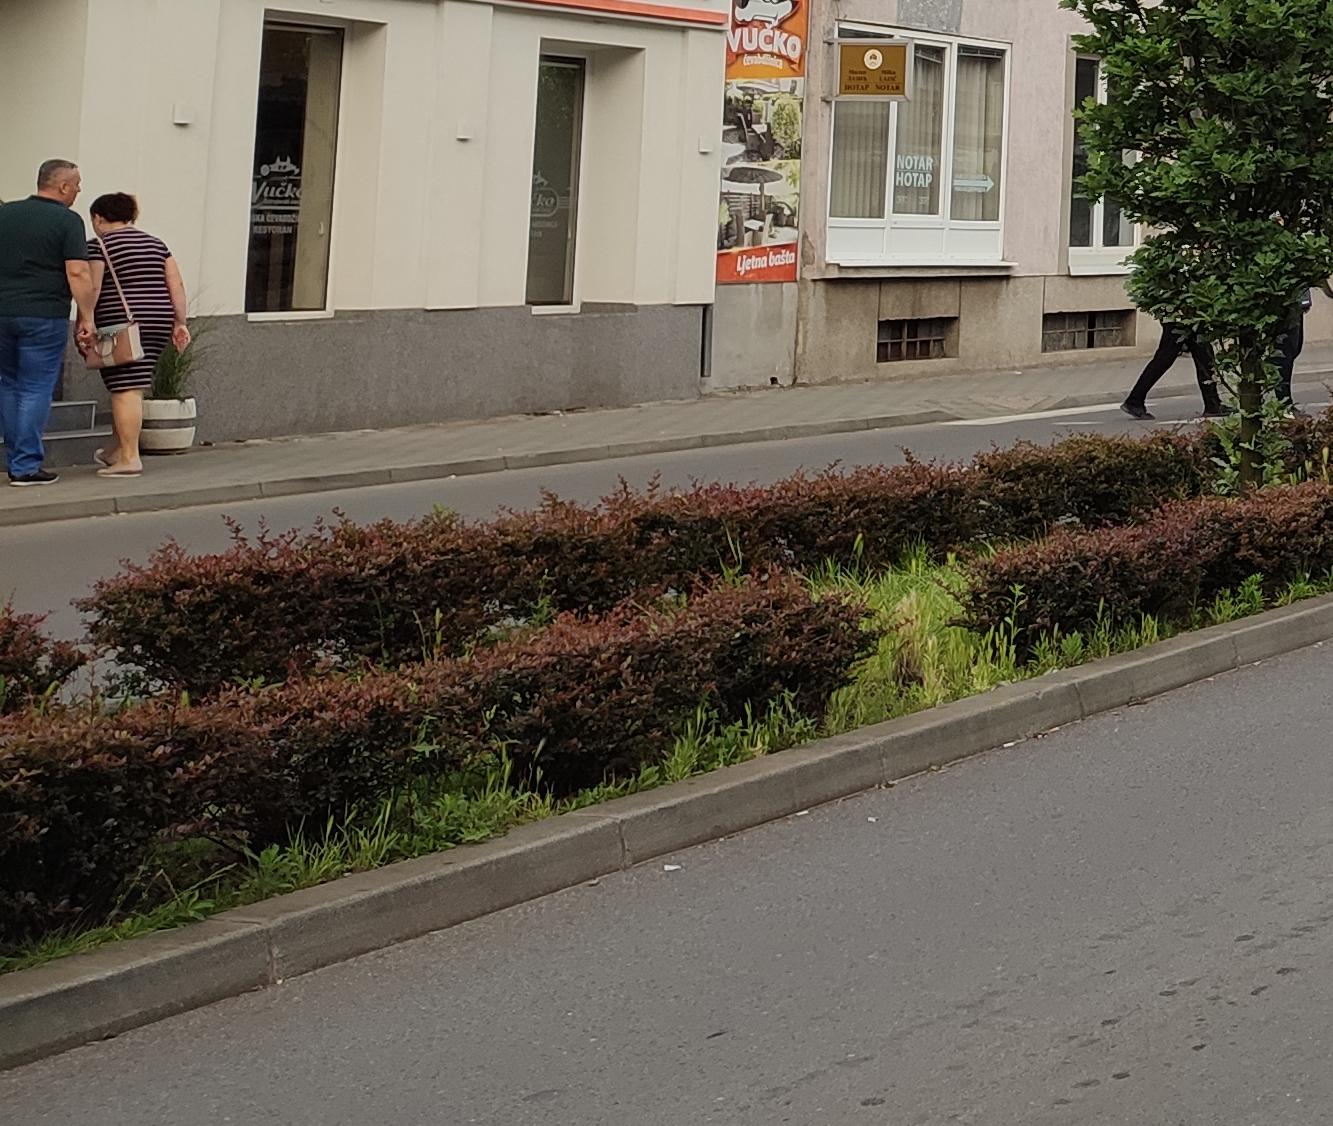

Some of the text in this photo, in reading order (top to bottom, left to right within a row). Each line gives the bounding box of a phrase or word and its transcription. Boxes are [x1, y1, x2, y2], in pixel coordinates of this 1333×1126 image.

[726, 22, 802, 60] VUČKO
[896, 155, 934, 171] NOTAR
[895, 171, 932, 187] НОТАР
[736, 249, 795, 275] Ljetna bašta
